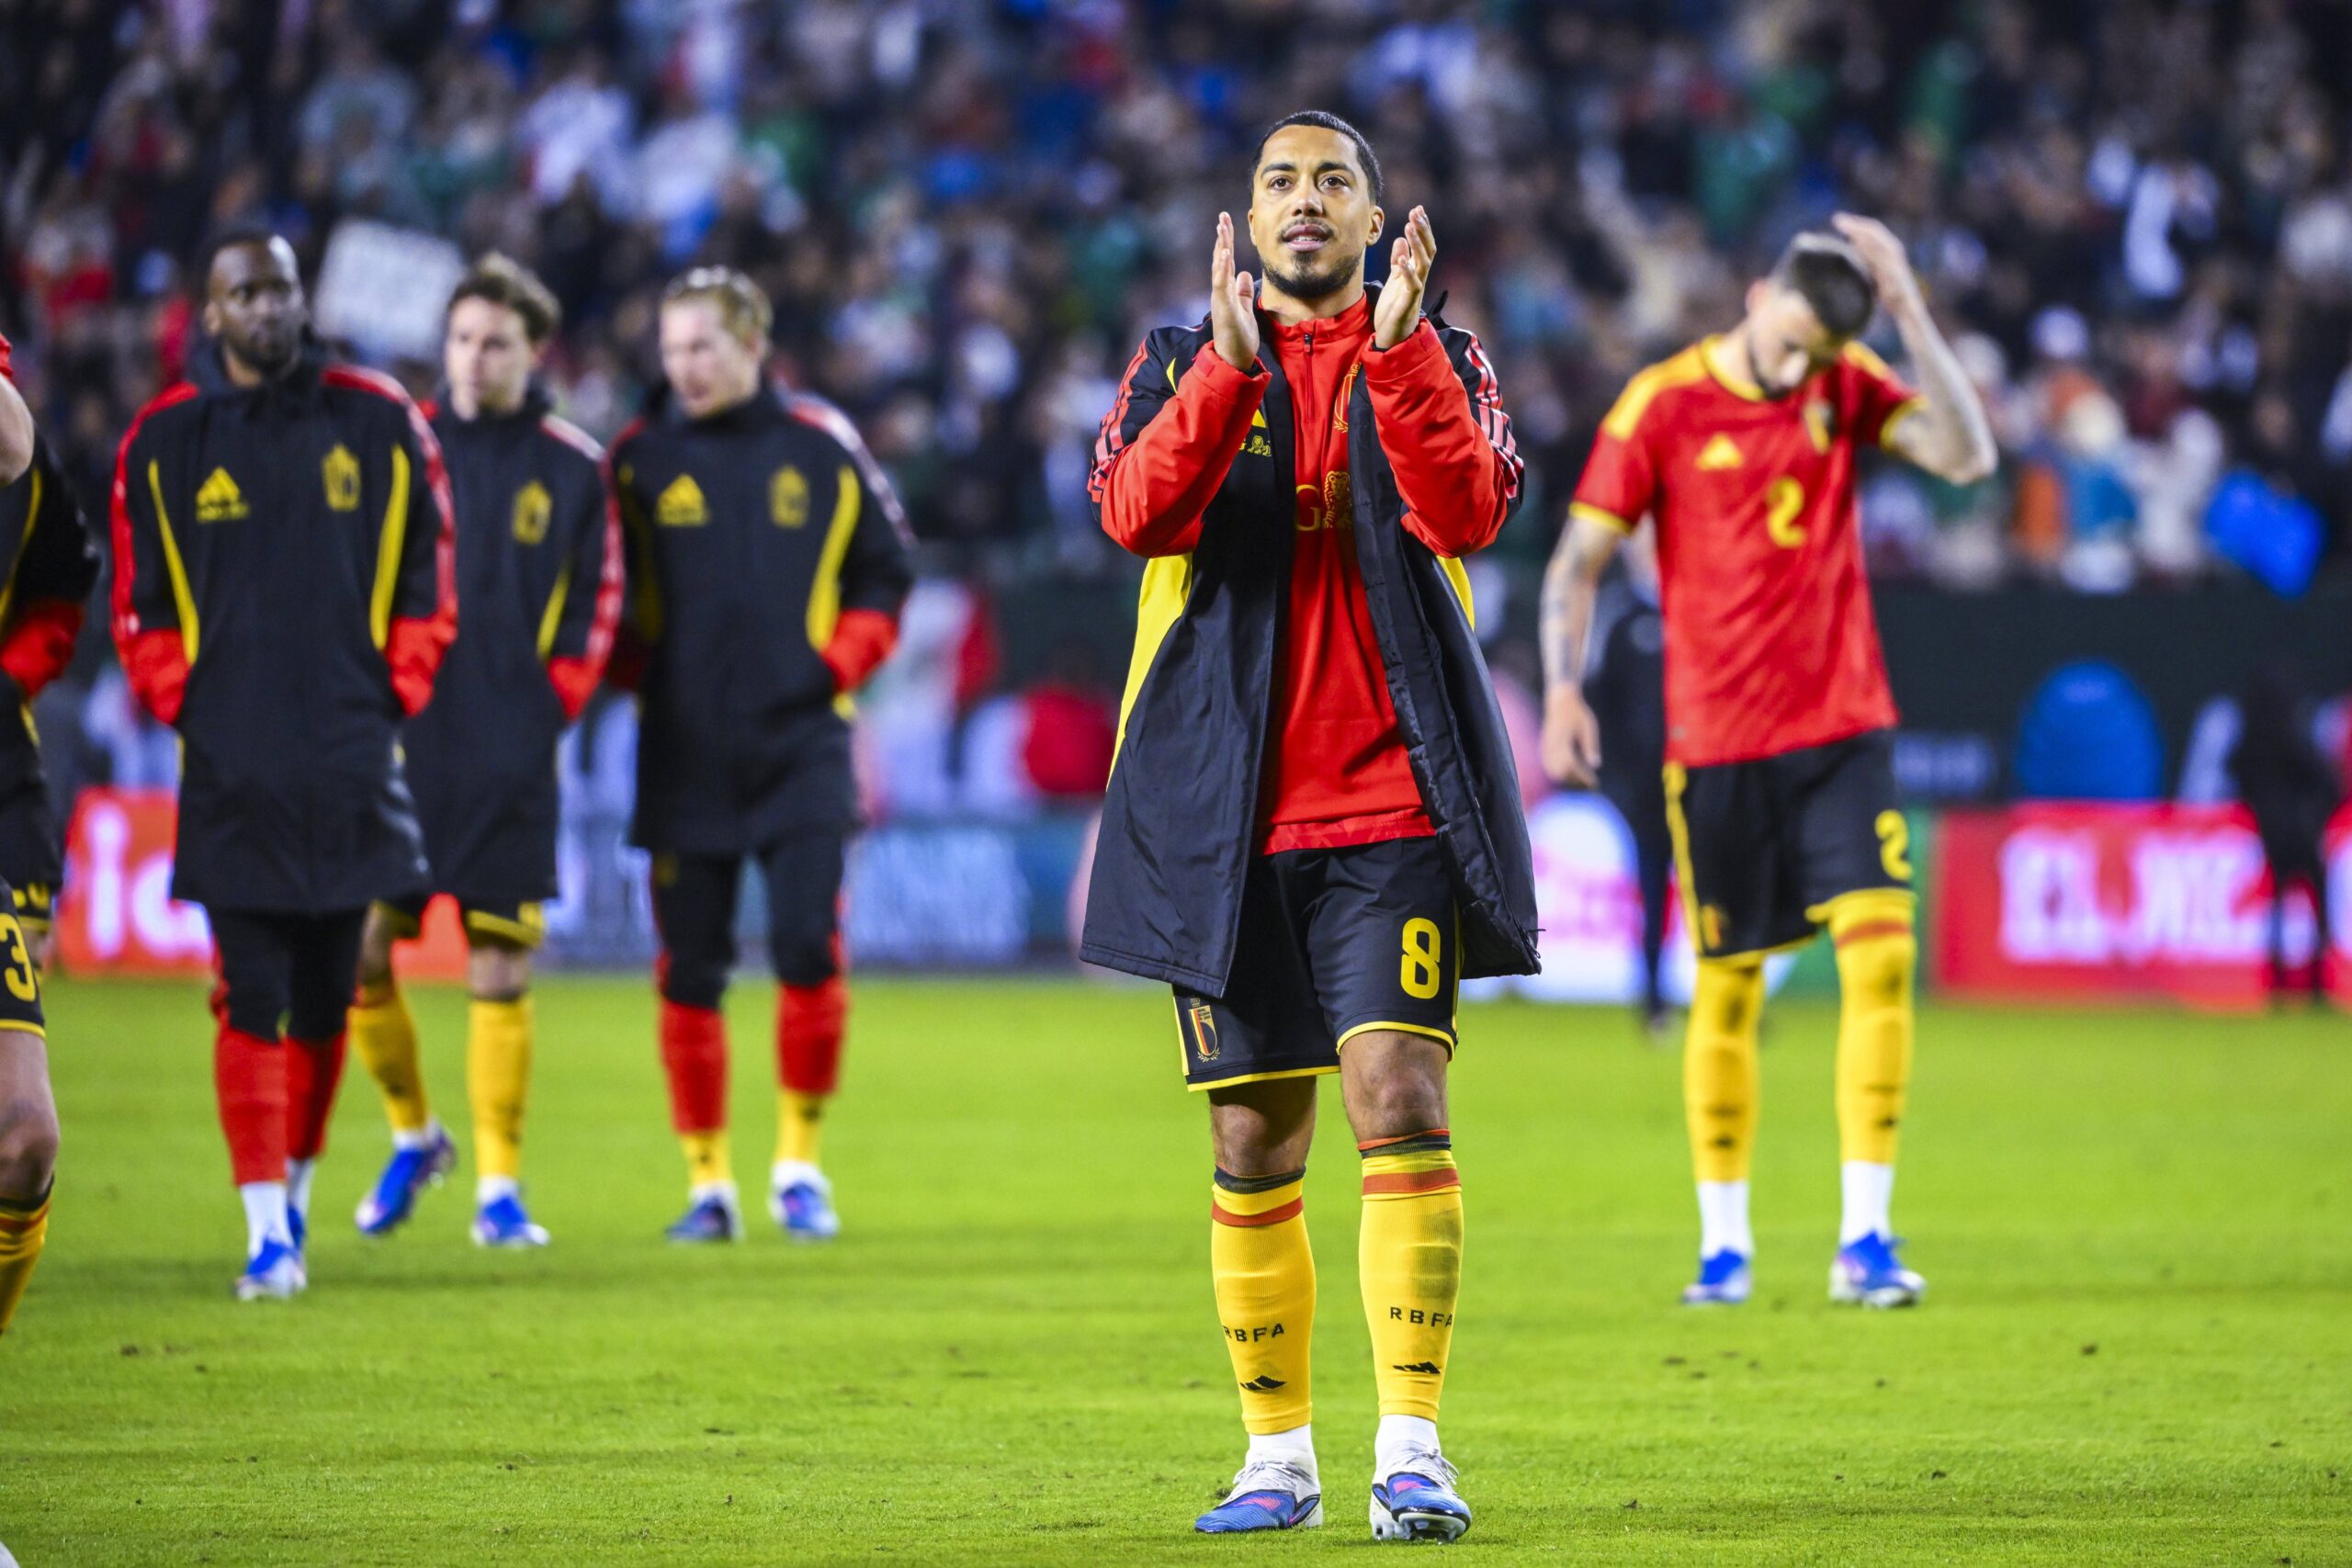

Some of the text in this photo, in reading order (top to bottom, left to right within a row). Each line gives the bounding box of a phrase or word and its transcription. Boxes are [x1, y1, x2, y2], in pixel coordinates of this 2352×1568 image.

[1767, 476, 1807, 547] 2
[1874, 809, 1914, 881] 2
[1400, 917, 1442, 999] 8
[1223, 1323, 1284, 1342] RBFA
[1390, 1306, 1453, 1327] RBFA
